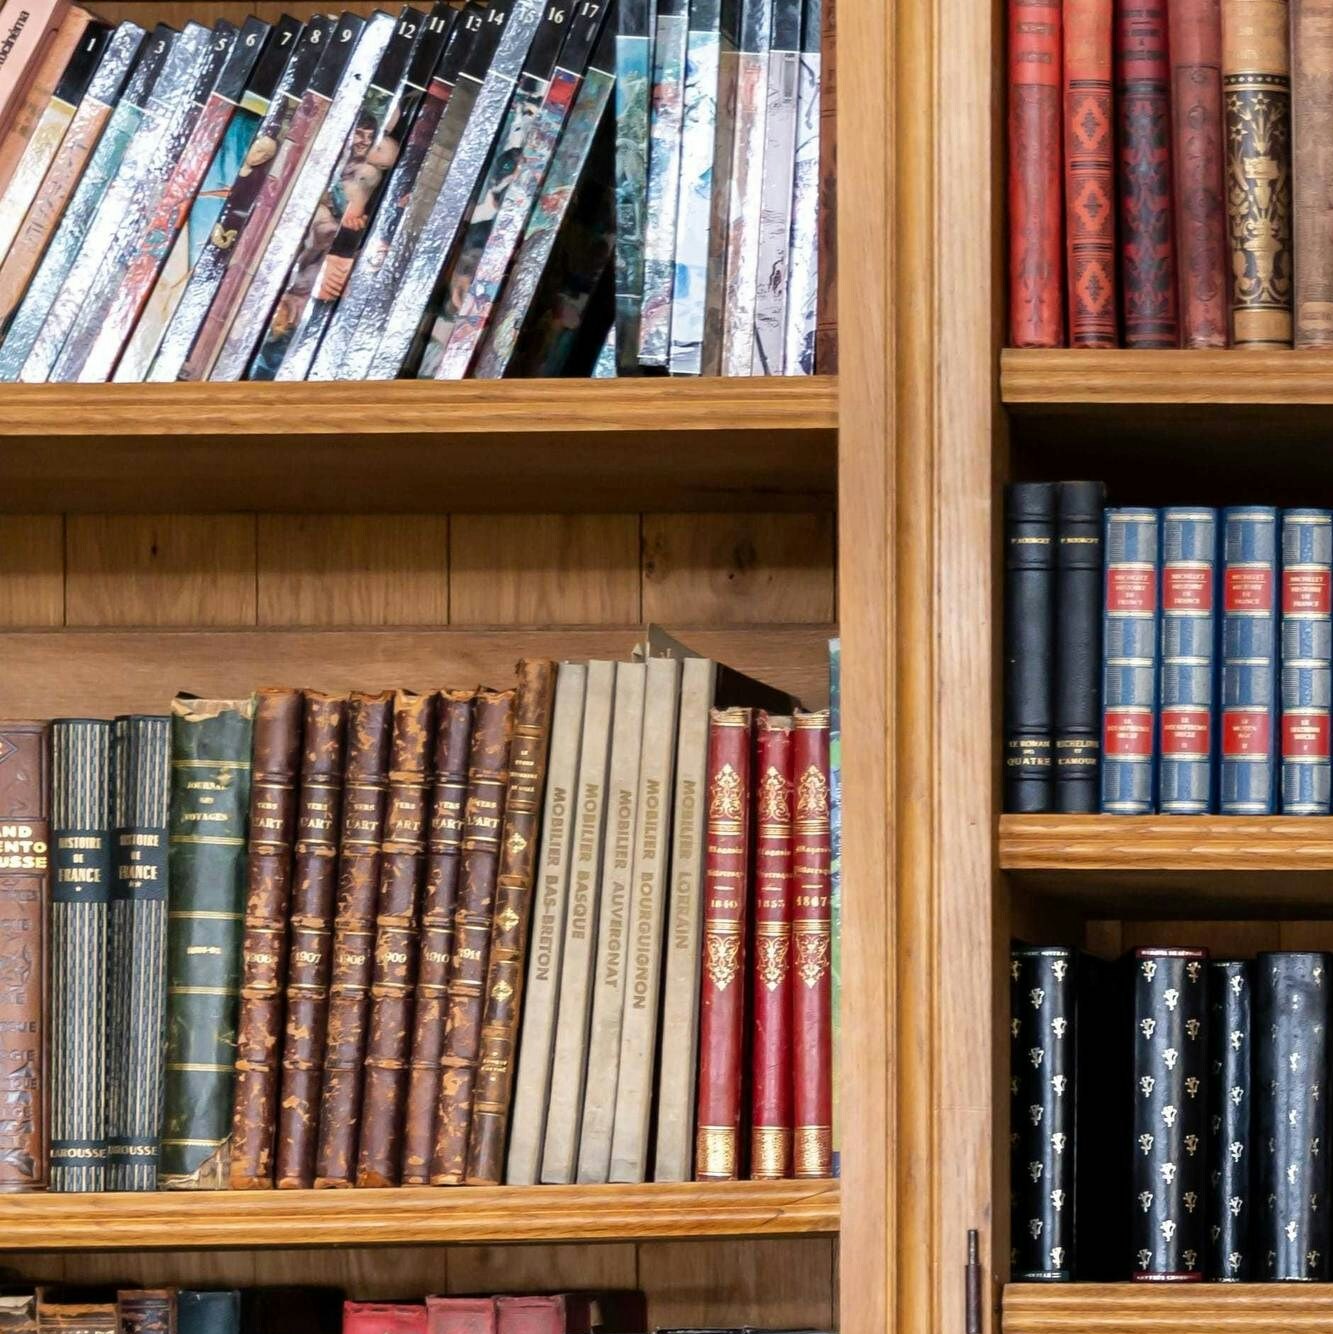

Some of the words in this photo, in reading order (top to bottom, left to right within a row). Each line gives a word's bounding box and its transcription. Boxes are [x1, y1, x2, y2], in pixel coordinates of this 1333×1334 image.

[487, 9, 504, 26] 14
[548, 7, 565, 24] 16
[582, 2, 599, 19] 17
[246, 34, 256, 46] 6
[280, 32, 292, 46] 7
[340, 29, 351, 42] 9
[87, 38, 96, 52] 1
[549, 786, 568, 868] MOBILIER
[577, 783, 599, 868] MOBILIER
[642, 779, 659, 860] MOBILIER
[679, 779, 695, 861] MOBILIER
[0, 826, 32, 837] AND
[612, 788, 633, 870] MOBILIER
[0, 842, 47, 853] ENTO
[0, 856, 47, 868] USSE
[73, 854, 84, 863] DE
[58, 868, 101, 882] FRANCE
[571, 870, 591, 940] BASQUE
[674, 871, 692, 950] LORRAIN
[535, 873, 561, 982] BAS-BRETON
[604, 881, 626, 988] AUVERGNAT
[632, 871, 654, 1010] BOURGUIGNON
[50, 1148, 107, 1158] LAROUSSE
